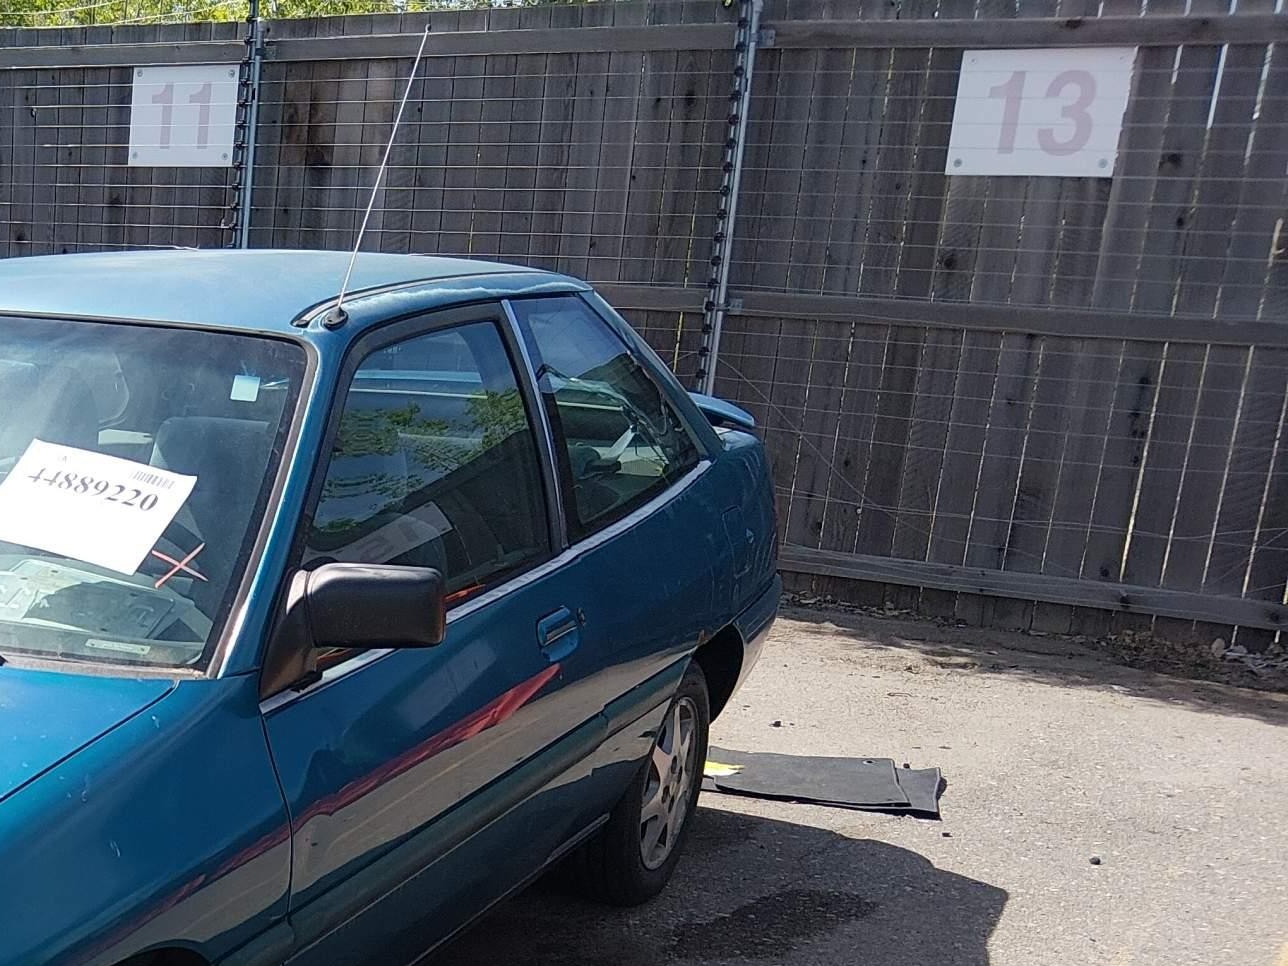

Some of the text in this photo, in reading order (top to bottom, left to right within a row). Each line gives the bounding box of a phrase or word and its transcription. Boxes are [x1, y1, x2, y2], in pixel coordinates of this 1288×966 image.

[151, 81, 212, 149] 11
[987, 70, 1097, 156] 13
[27, 467, 159, 511] 44889220
